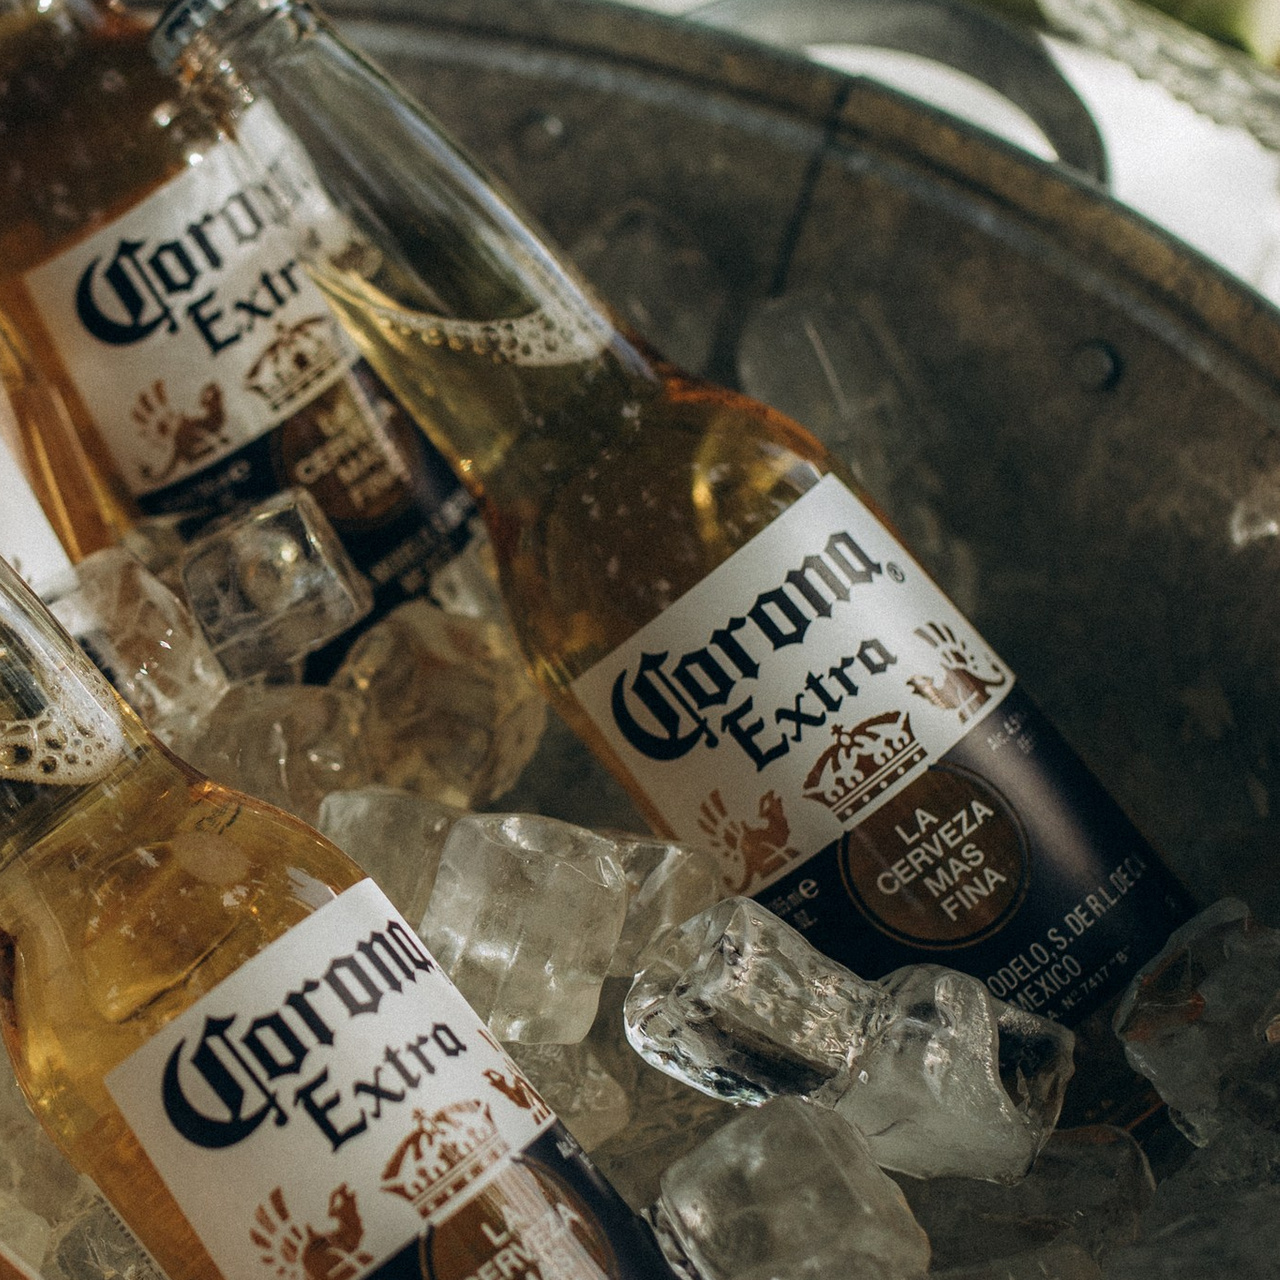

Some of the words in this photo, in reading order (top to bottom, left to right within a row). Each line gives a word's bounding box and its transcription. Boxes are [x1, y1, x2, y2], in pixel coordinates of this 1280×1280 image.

[610, 530, 884, 762] Corona
[720, 633, 898, 772] Extra
[876, 799, 995, 896] CERVEZA
[894, 807, 940, 846] LA
[924, 842, 986, 900] MAS
[940, 870, 1007, 924] FINA
[986, 941, 1057, 998] ODELO,
[1051, 926, 1075, 953] S.
[1066, 905, 1094, 937] DE
[162, 919, 437, 1152] Corona
[293, 1021, 469, 1154] Extra
